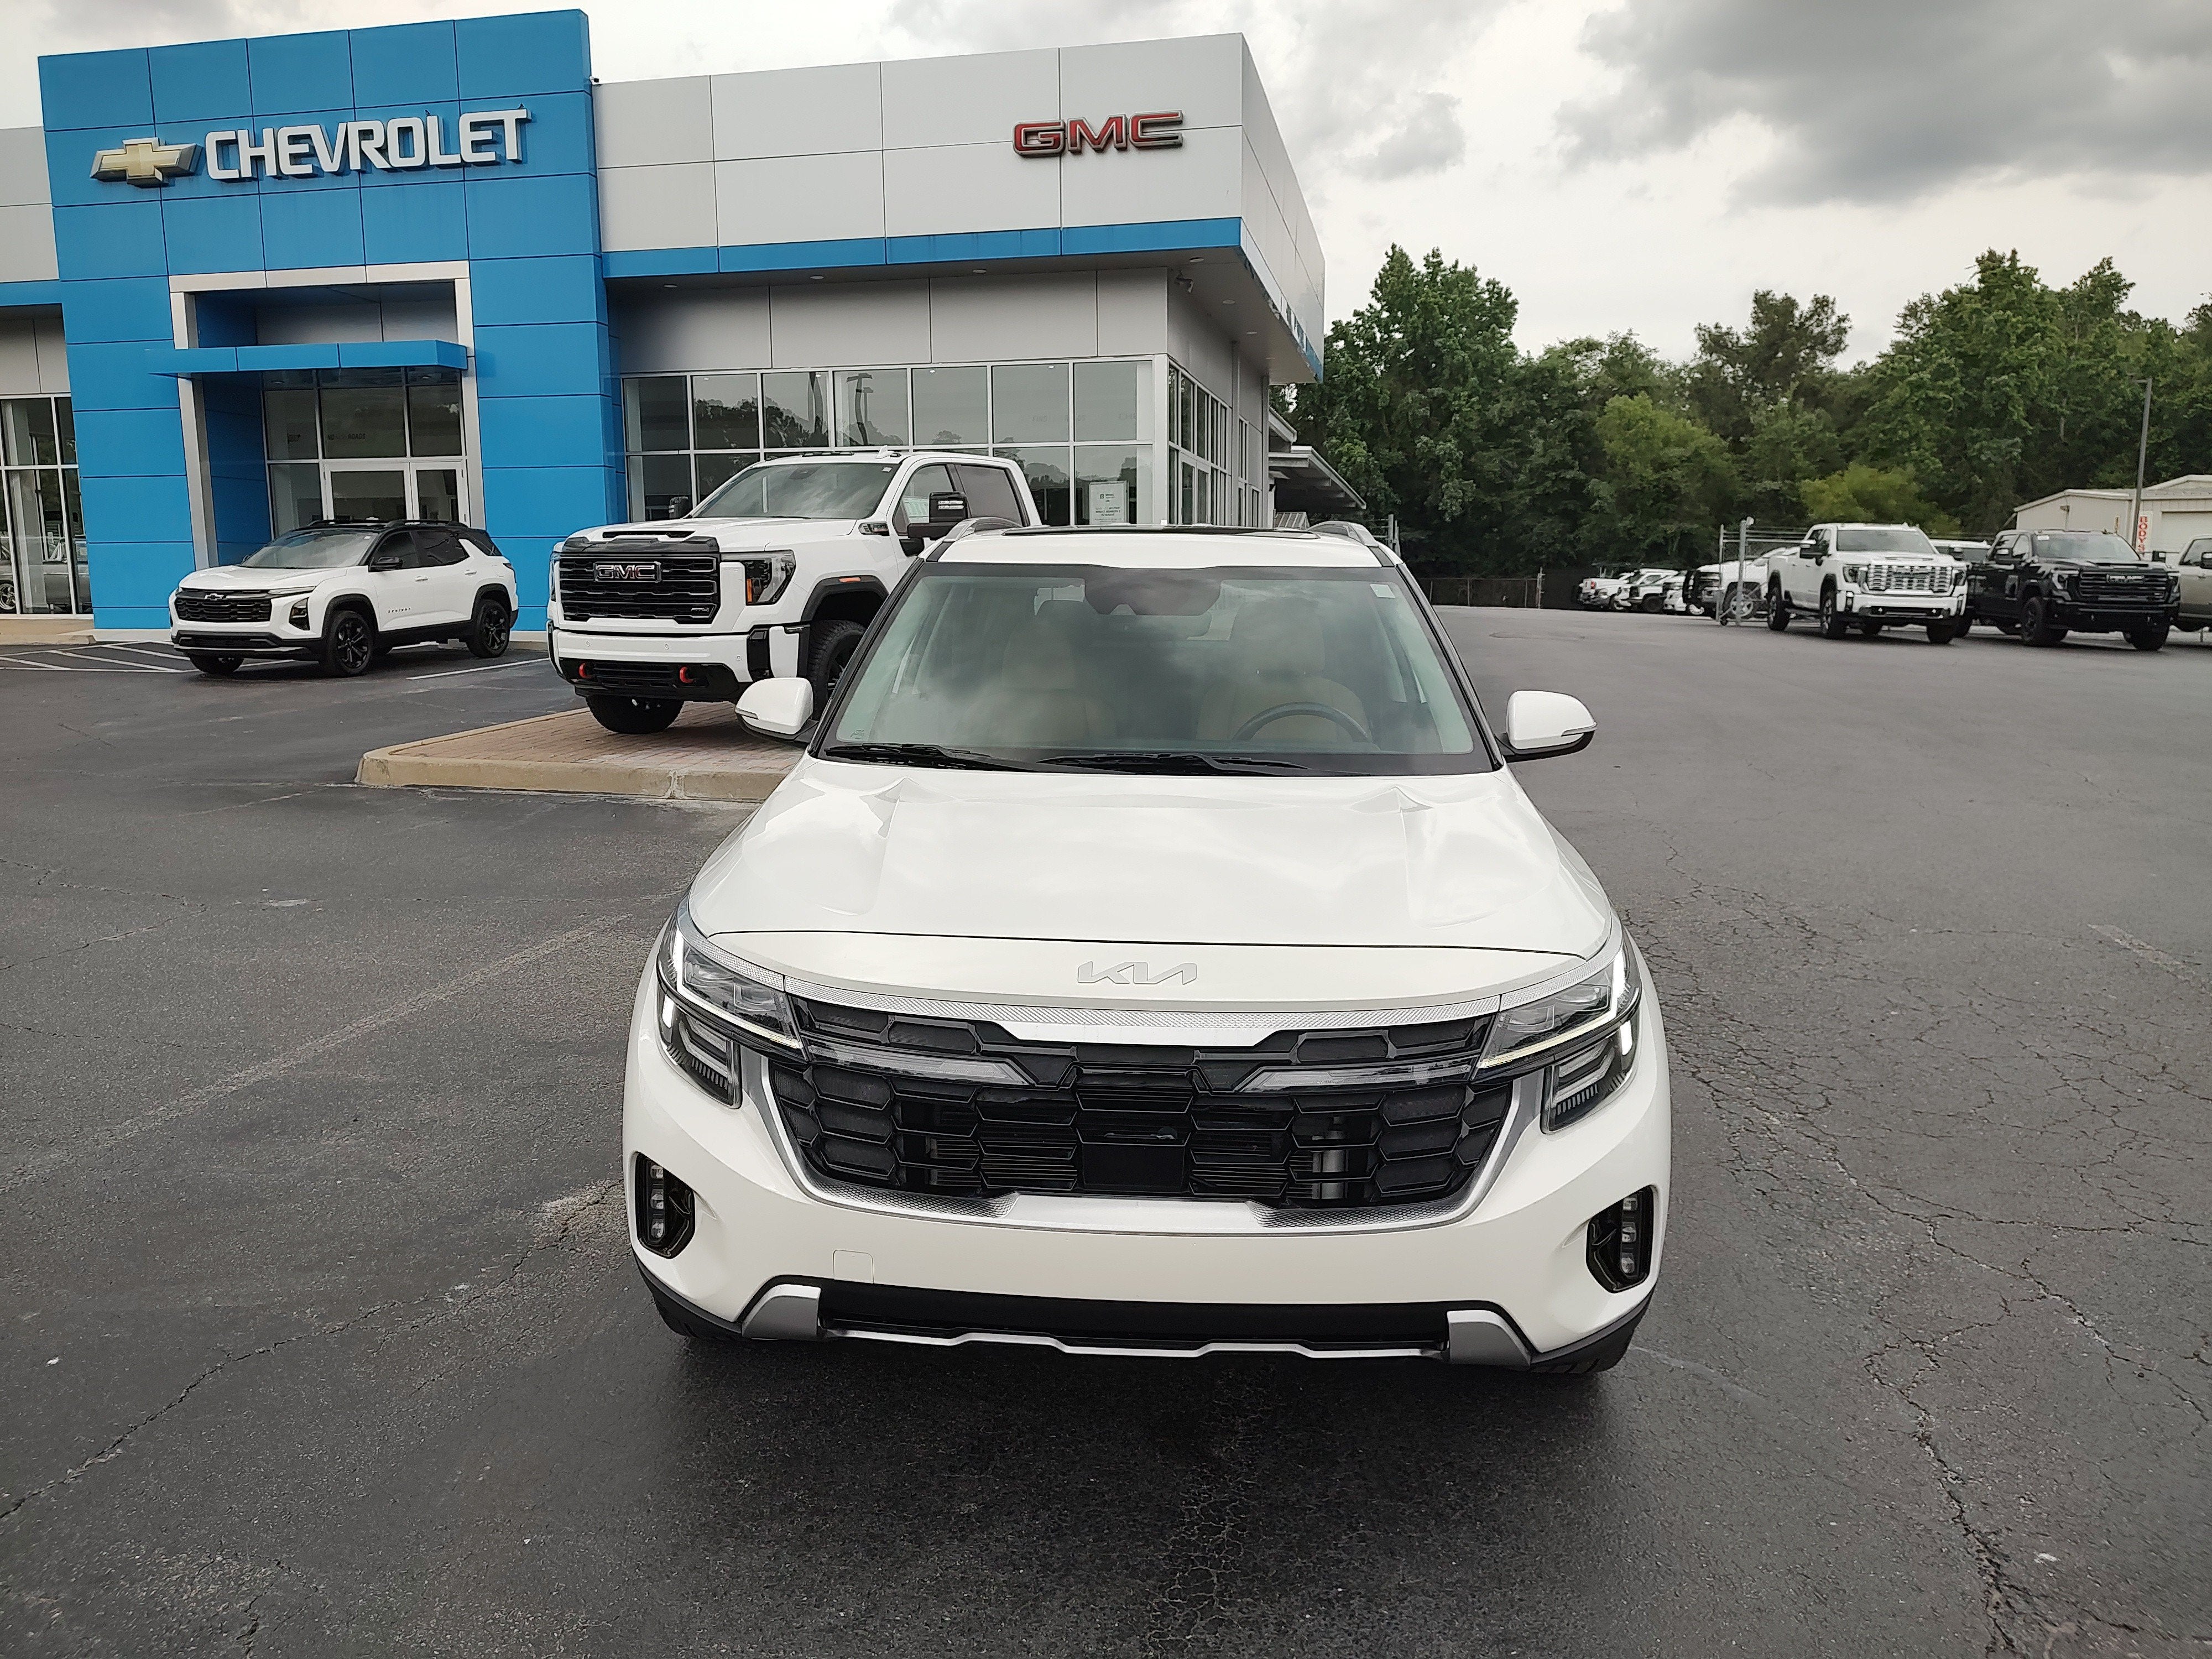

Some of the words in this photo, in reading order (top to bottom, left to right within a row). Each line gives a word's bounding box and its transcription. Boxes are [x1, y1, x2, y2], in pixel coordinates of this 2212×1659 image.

[205, 108, 531, 181] CHEVROLET
[1013, 109, 1183, 158] GMC
[596, 565, 655, 579] GMC
[1077, 961, 1197, 985] KIA
